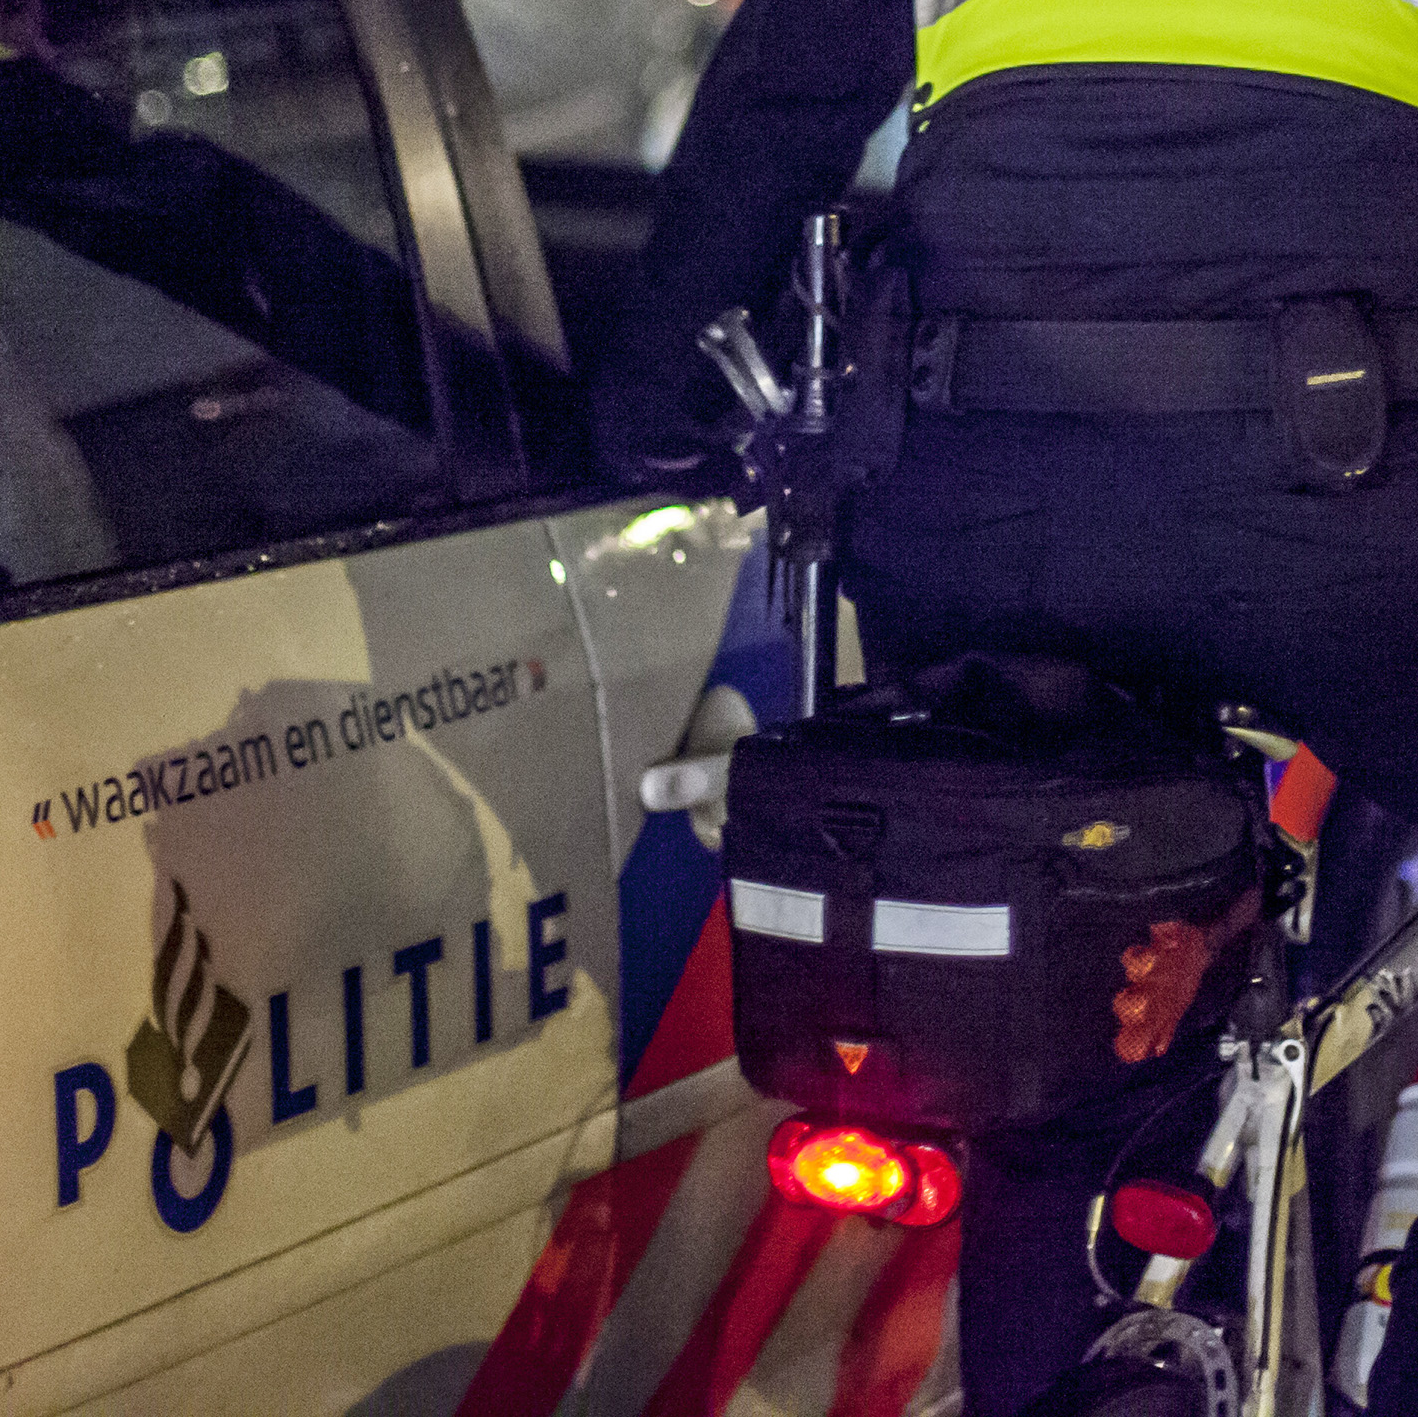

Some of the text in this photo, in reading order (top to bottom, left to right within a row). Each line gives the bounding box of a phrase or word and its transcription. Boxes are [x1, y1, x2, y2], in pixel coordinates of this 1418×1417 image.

[61, 658, 518, 836] waakzaam en dienstbaar
[53, 891, 569, 1234] POLITIE
